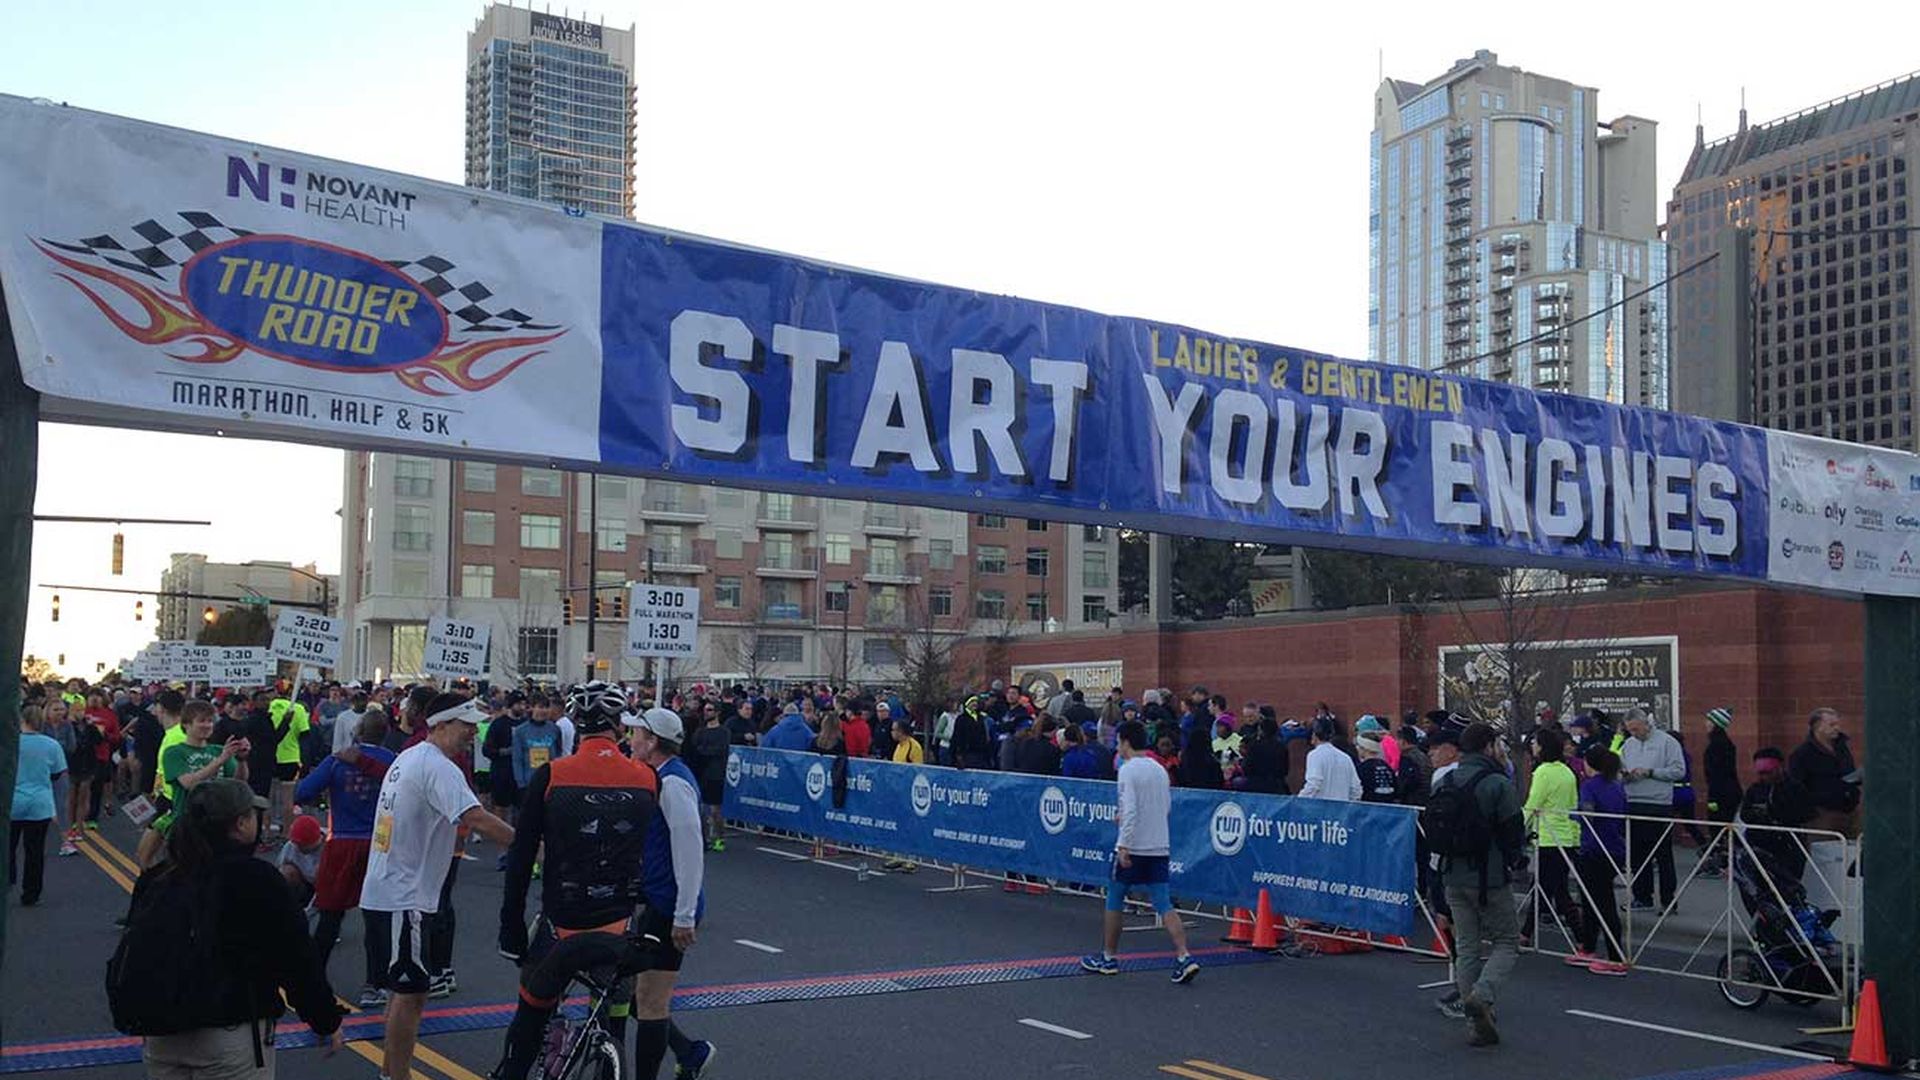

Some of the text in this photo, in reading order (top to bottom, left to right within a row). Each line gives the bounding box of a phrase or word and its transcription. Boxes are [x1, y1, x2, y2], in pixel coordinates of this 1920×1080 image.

[560, 18, 592, 35] VUE
[533, 25, 600, 49] NOW LEASING
[306, 172, 416, 211] NOVANT
[304, 196, 406, 231] HEALTH
[217, 256, 418, 326] THUNDER
[258, 303, 381, 355] ROAD
[1151, 329, 1463, 413] LADIES & GENTLEMEN
[329, 398, 383, 426] HALF
[396, 409, 411, 431] &
[422, 412, 450, 436] 5K
[669, 309, 1740, 557] START YOUR ENGINES
[648, 590, 684, 607] 3:00
[634, 608, 694, 620] FULL MARATHON
[295, 615, 331, 632] 3:20
[445, 623, 475, 639] 3:10
[649, 622, 680, 639] 1:30
[301, 630, 339, 642] MARATHON
[182, 648, 210, 657] 3:40
[291, 637, 324, 654] 1:40
[449, 640, 483, 651] MARATHON
[632, 641, 692, 651] HALF MARATHON
[222, 649, 253, 660] 3:30
[296, 653, 334, 665] MARATHON
[442, 649, 470, 664] 1:35
[183, 664, 208, 673] 1:50
[224, 667, 252, 677] 1:45
[445, 665, 479, 676] MARATHON
[1572, 657, 1658, 679] HISTORY
[932, 783, 946, 802] for
[947, 788, 971, 807] your
[971, 787, 988, 807] life
[1043, 796, 1117, 823] run for your
[1216, 813, 1348, 846] run for your life
[1251, 870, 1295, 888] HAPPINESS
[1295, 876, 1319, 892] RUNS
[1319, 880, 1329, 893] IN
[1329, 882, 1348, 896] OUR
